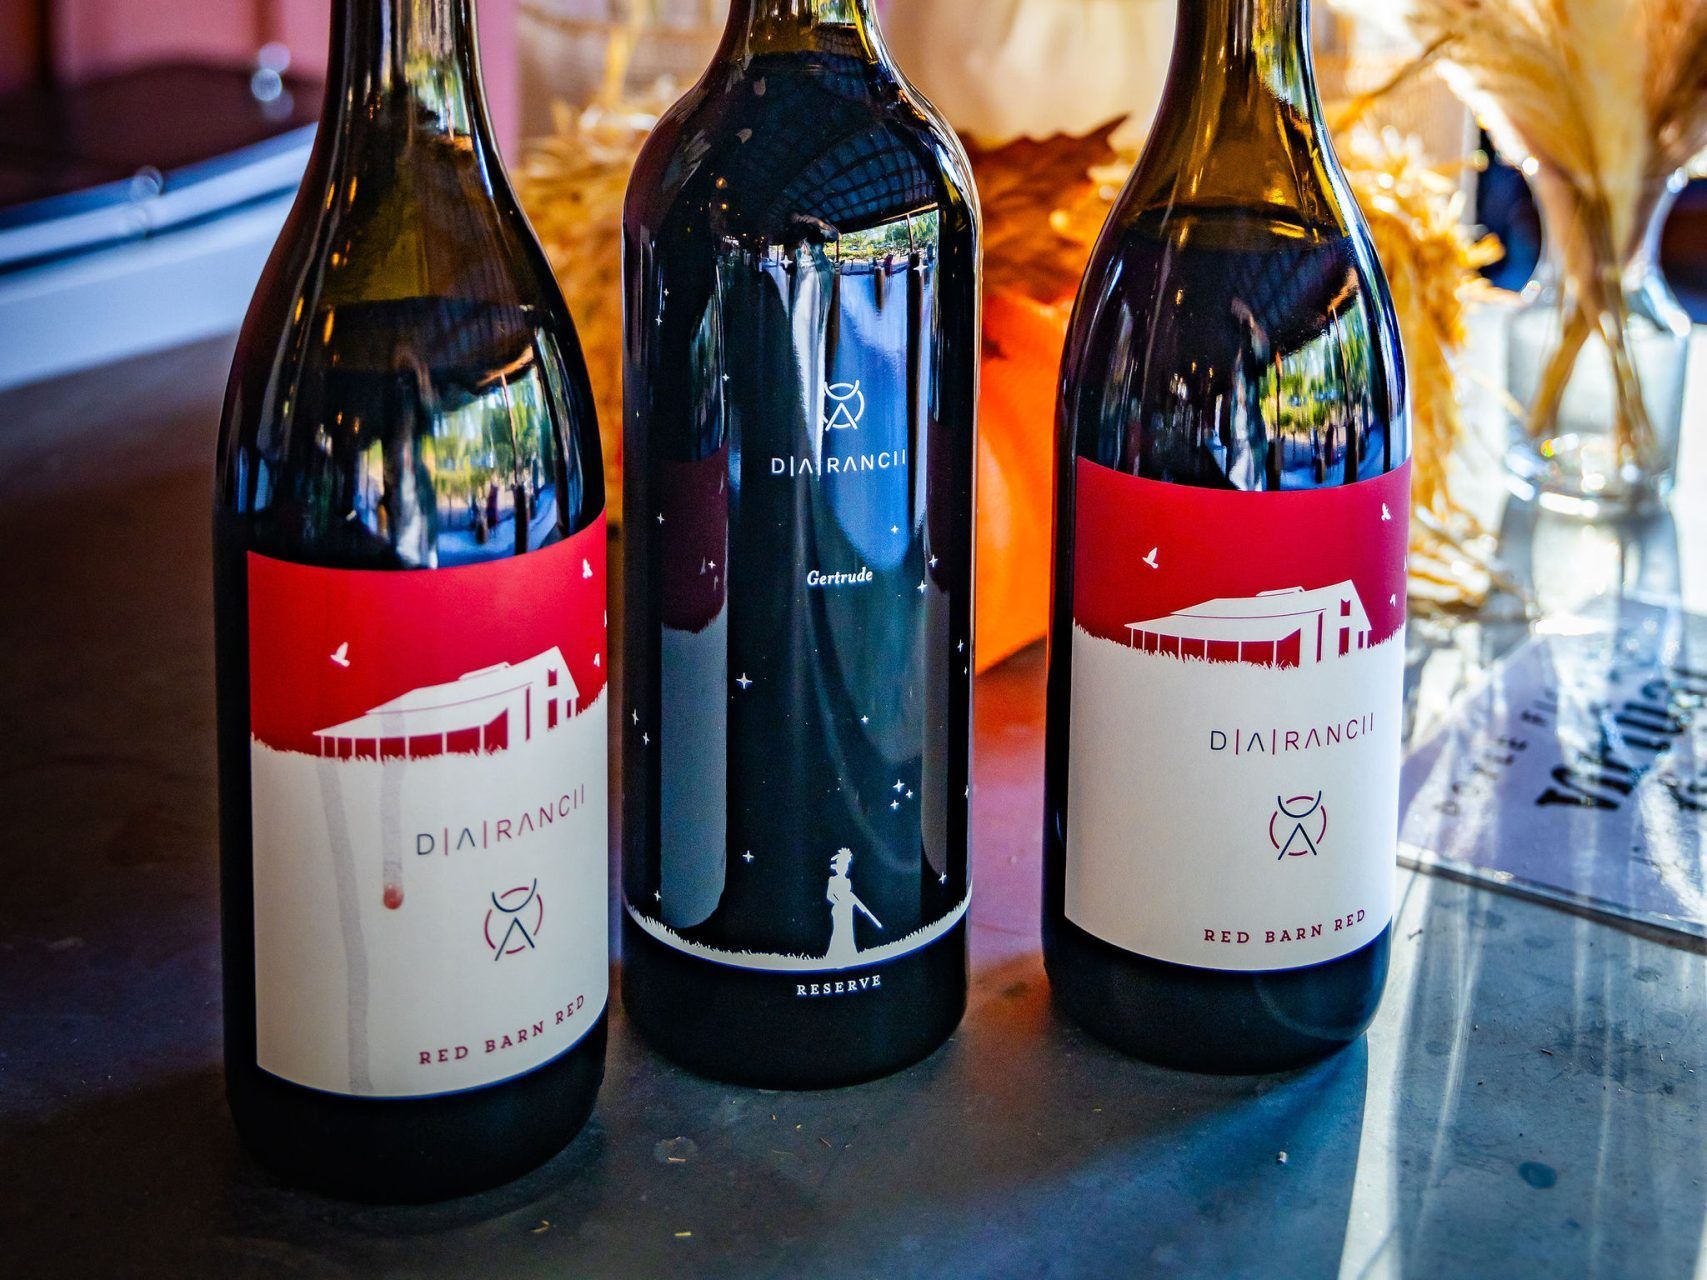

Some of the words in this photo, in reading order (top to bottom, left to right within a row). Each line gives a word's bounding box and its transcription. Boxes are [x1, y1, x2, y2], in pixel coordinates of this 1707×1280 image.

[806, 566, 874, 586] Gertrude
[1203, 928, 1250, 944] RED
[1264, 923, 1323, 943] BARN
[1333, 908, 1367, 932] RED
[796, 974, 881, 996] RESERVE
[418, 1045, 469, 1065] RED
[484, 1020, 545, 1054] BARN
[555, 994, 585, 1026] RED
